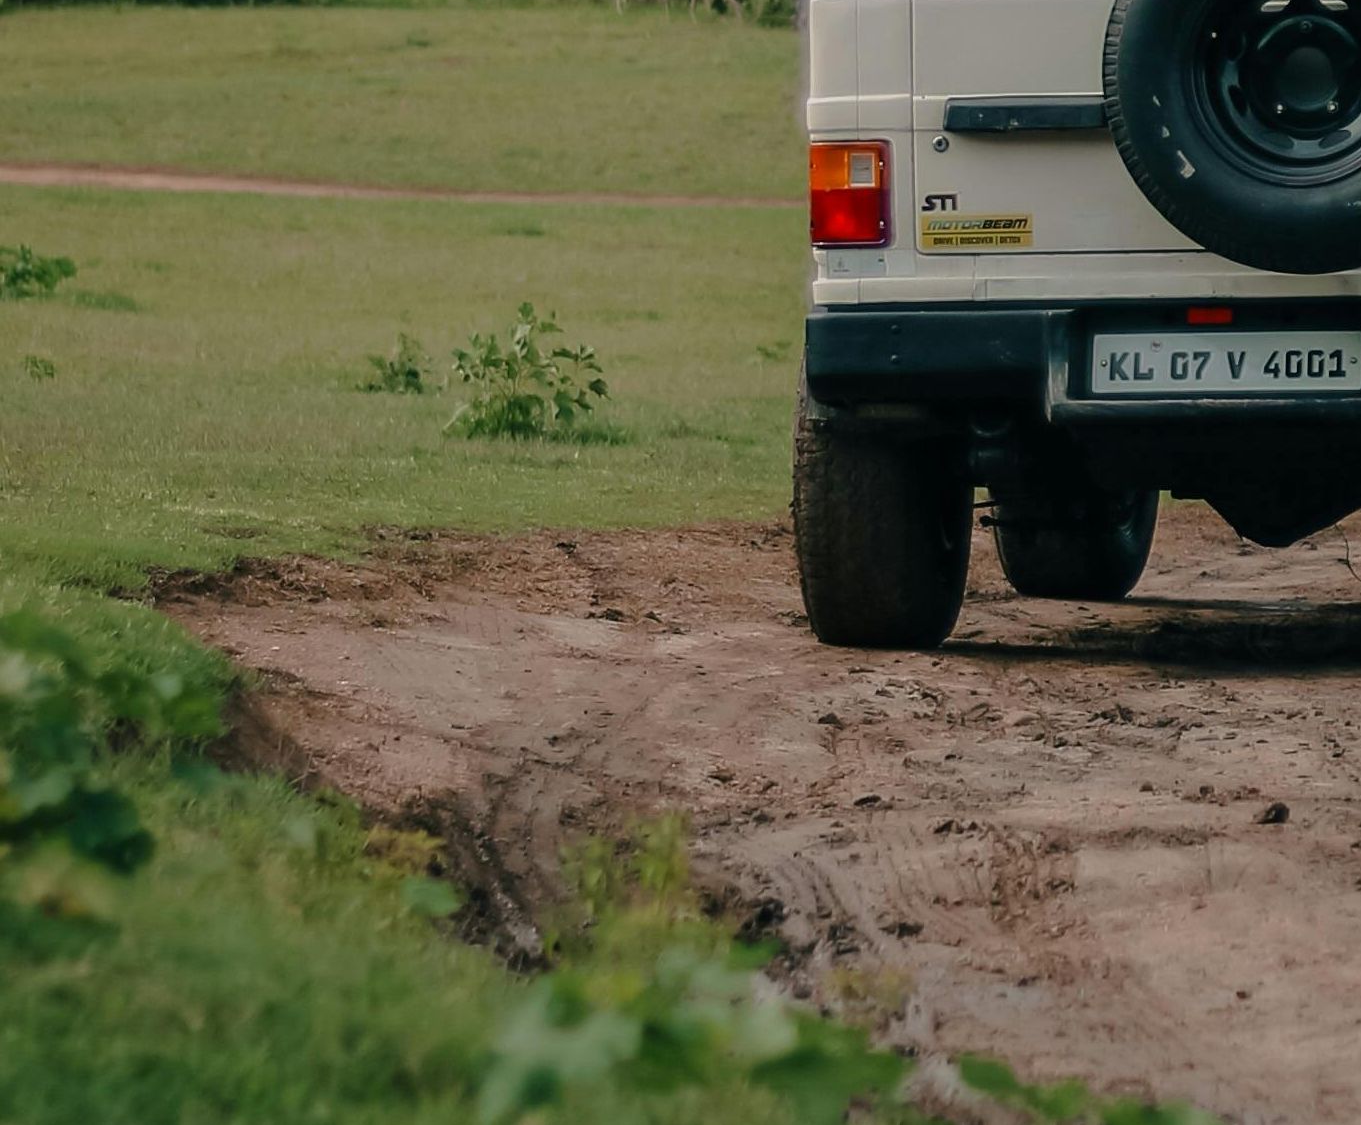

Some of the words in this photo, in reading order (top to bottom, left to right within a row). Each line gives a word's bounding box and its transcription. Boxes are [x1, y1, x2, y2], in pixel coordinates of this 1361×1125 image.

[1109, 352, 1154, 381] KL
[1170, 351, 1211, 380] 07
[1227, 350, 1246, 379] V
[1263, 349, 1347, 378] 4001
